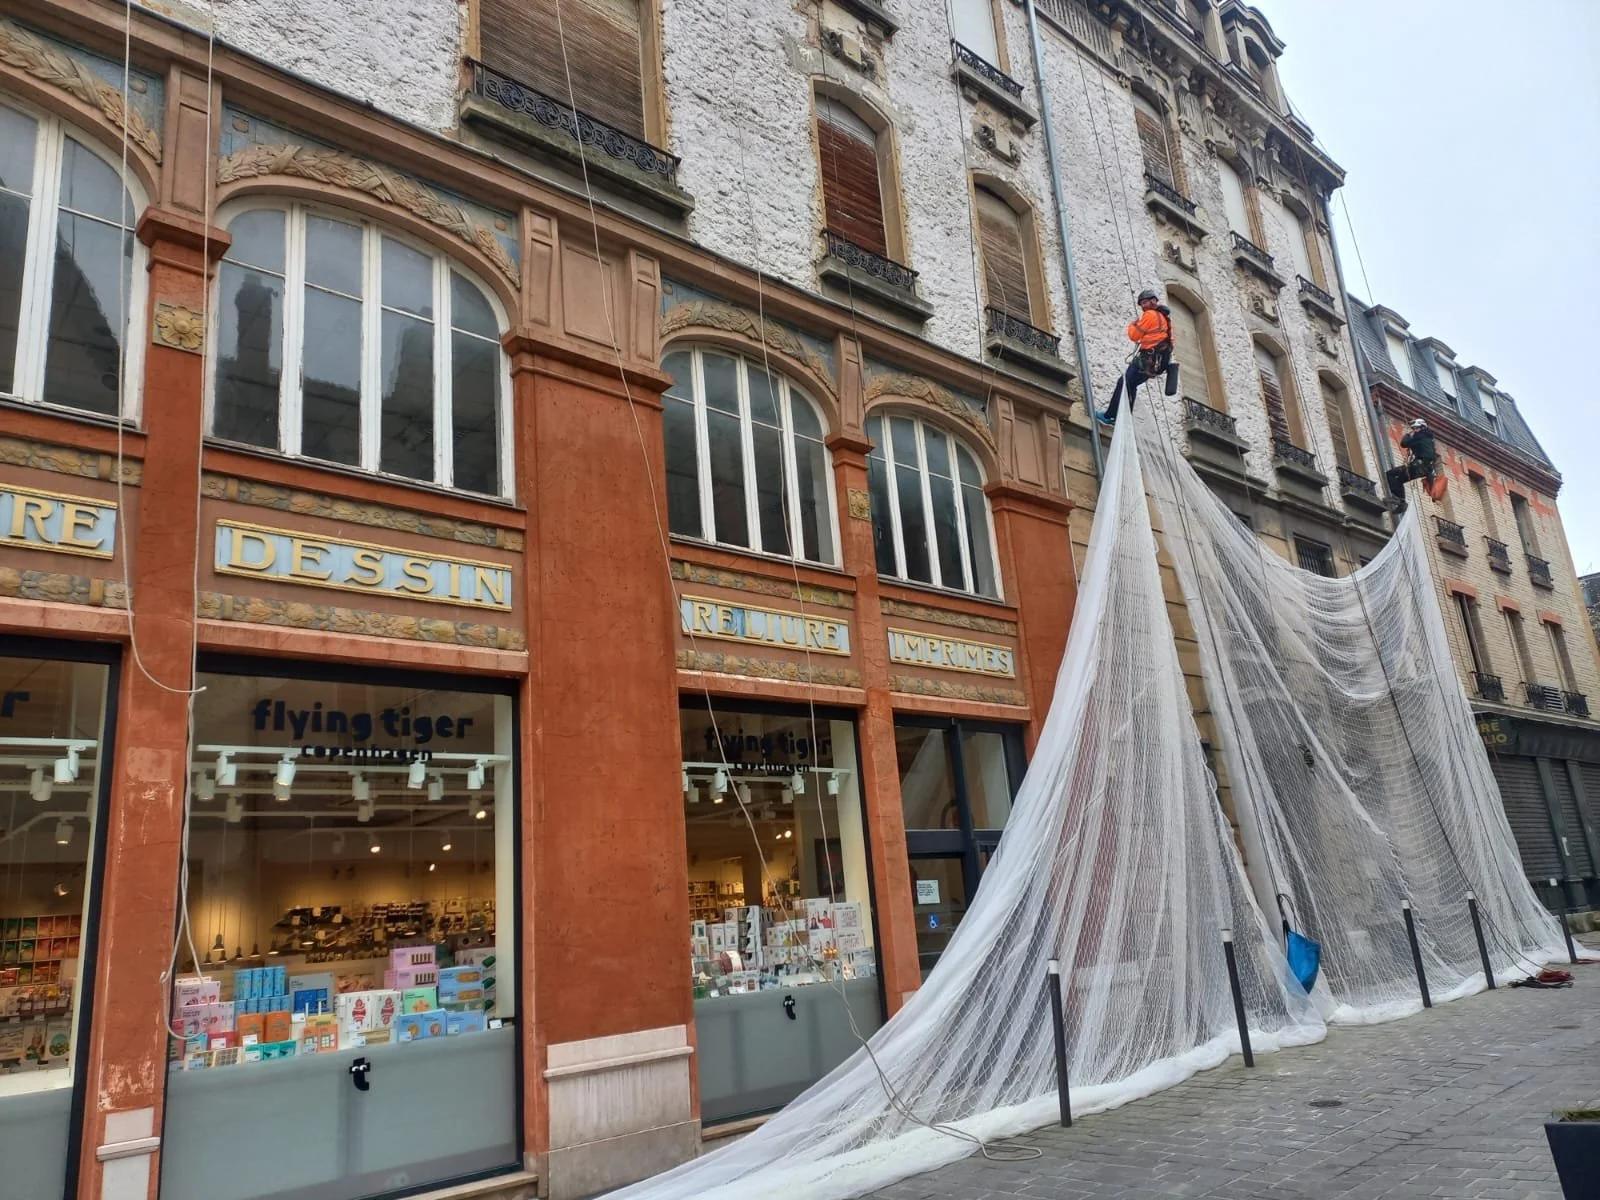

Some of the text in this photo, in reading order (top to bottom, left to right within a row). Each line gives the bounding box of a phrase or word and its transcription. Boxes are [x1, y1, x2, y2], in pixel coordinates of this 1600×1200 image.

[0, 490, 104, 549] RE
[227, 529, 504, 604] DESSIN
[692, 602, 841, 650] RELIURE
[893, 632, 1010, 674] IMPRIMES
[252, 698, 474, 744] flying tiger
[301, 743, 433, 762] copenhagen
